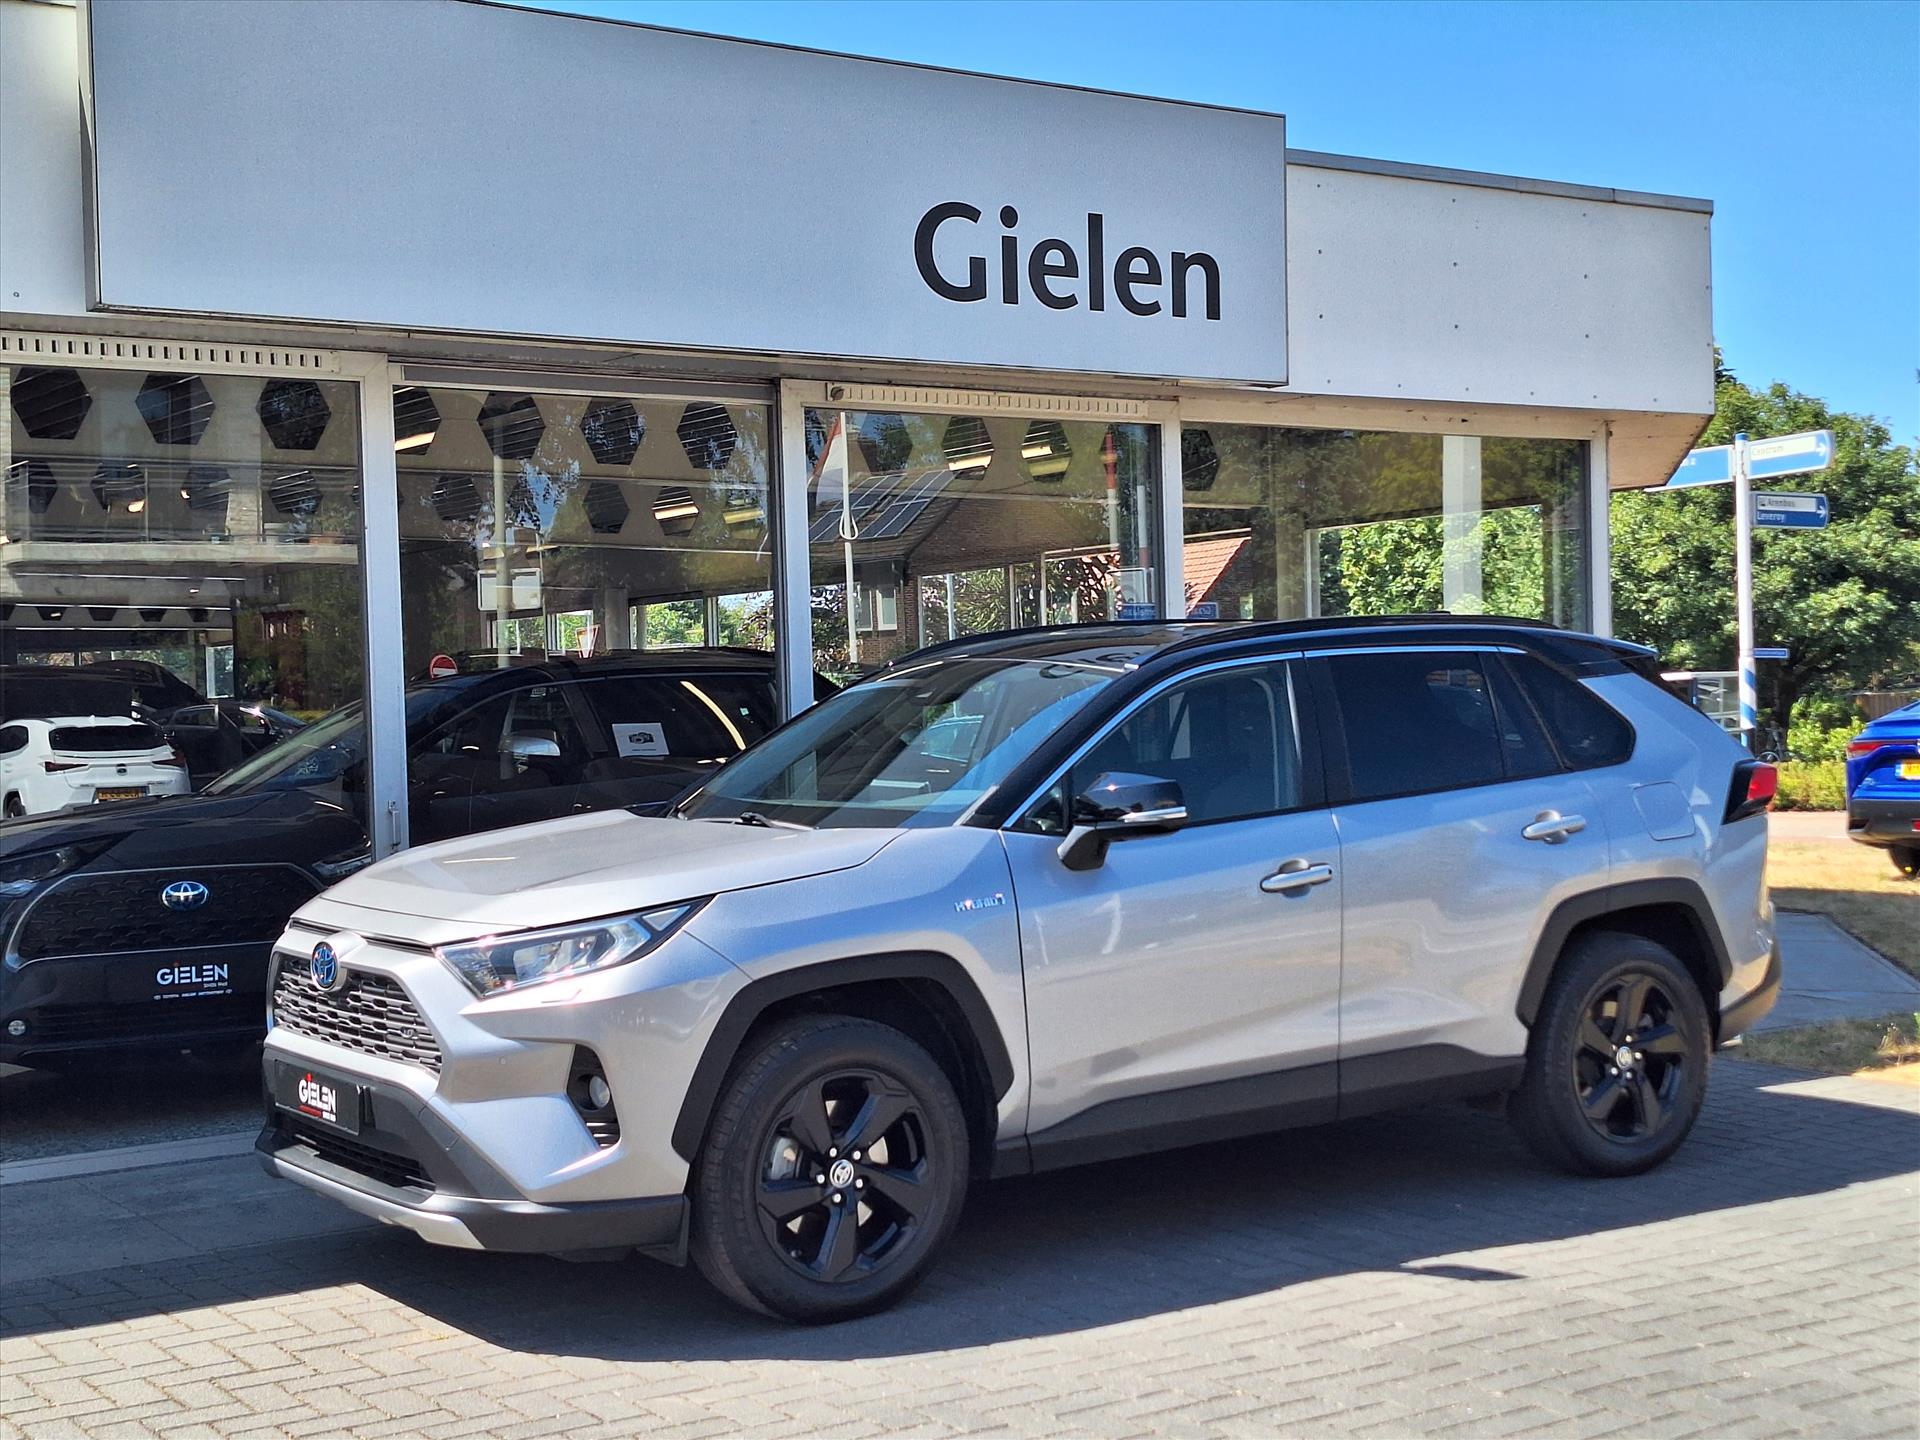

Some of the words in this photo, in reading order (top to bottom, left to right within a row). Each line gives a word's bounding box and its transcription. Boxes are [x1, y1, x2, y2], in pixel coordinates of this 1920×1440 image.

[914, 201, 1221, 321] Gielen
[156, 962, 229, 985] GIELEN
[298, 1073, 337, 1113] GIELEN
